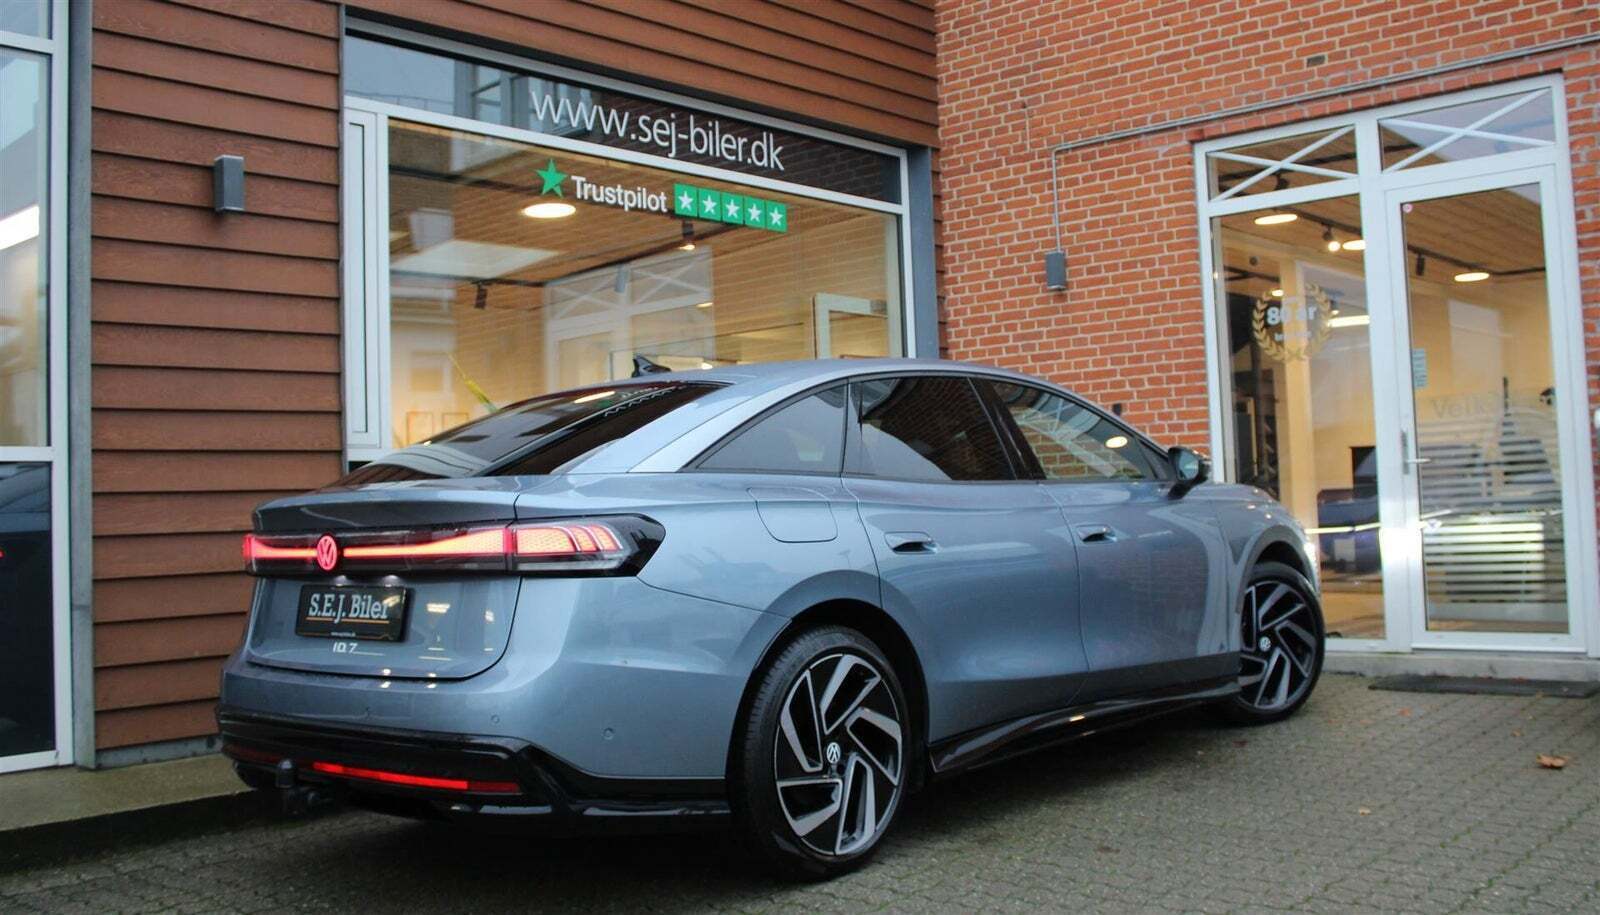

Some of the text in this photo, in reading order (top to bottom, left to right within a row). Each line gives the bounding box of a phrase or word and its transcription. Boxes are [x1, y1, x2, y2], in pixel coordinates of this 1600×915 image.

[529, 90, 785, 171] www.sej-biler.dk
[570, 175, 668, 213] Trustpilot
[308, 593, 389, 623] S.E.J. Biler
